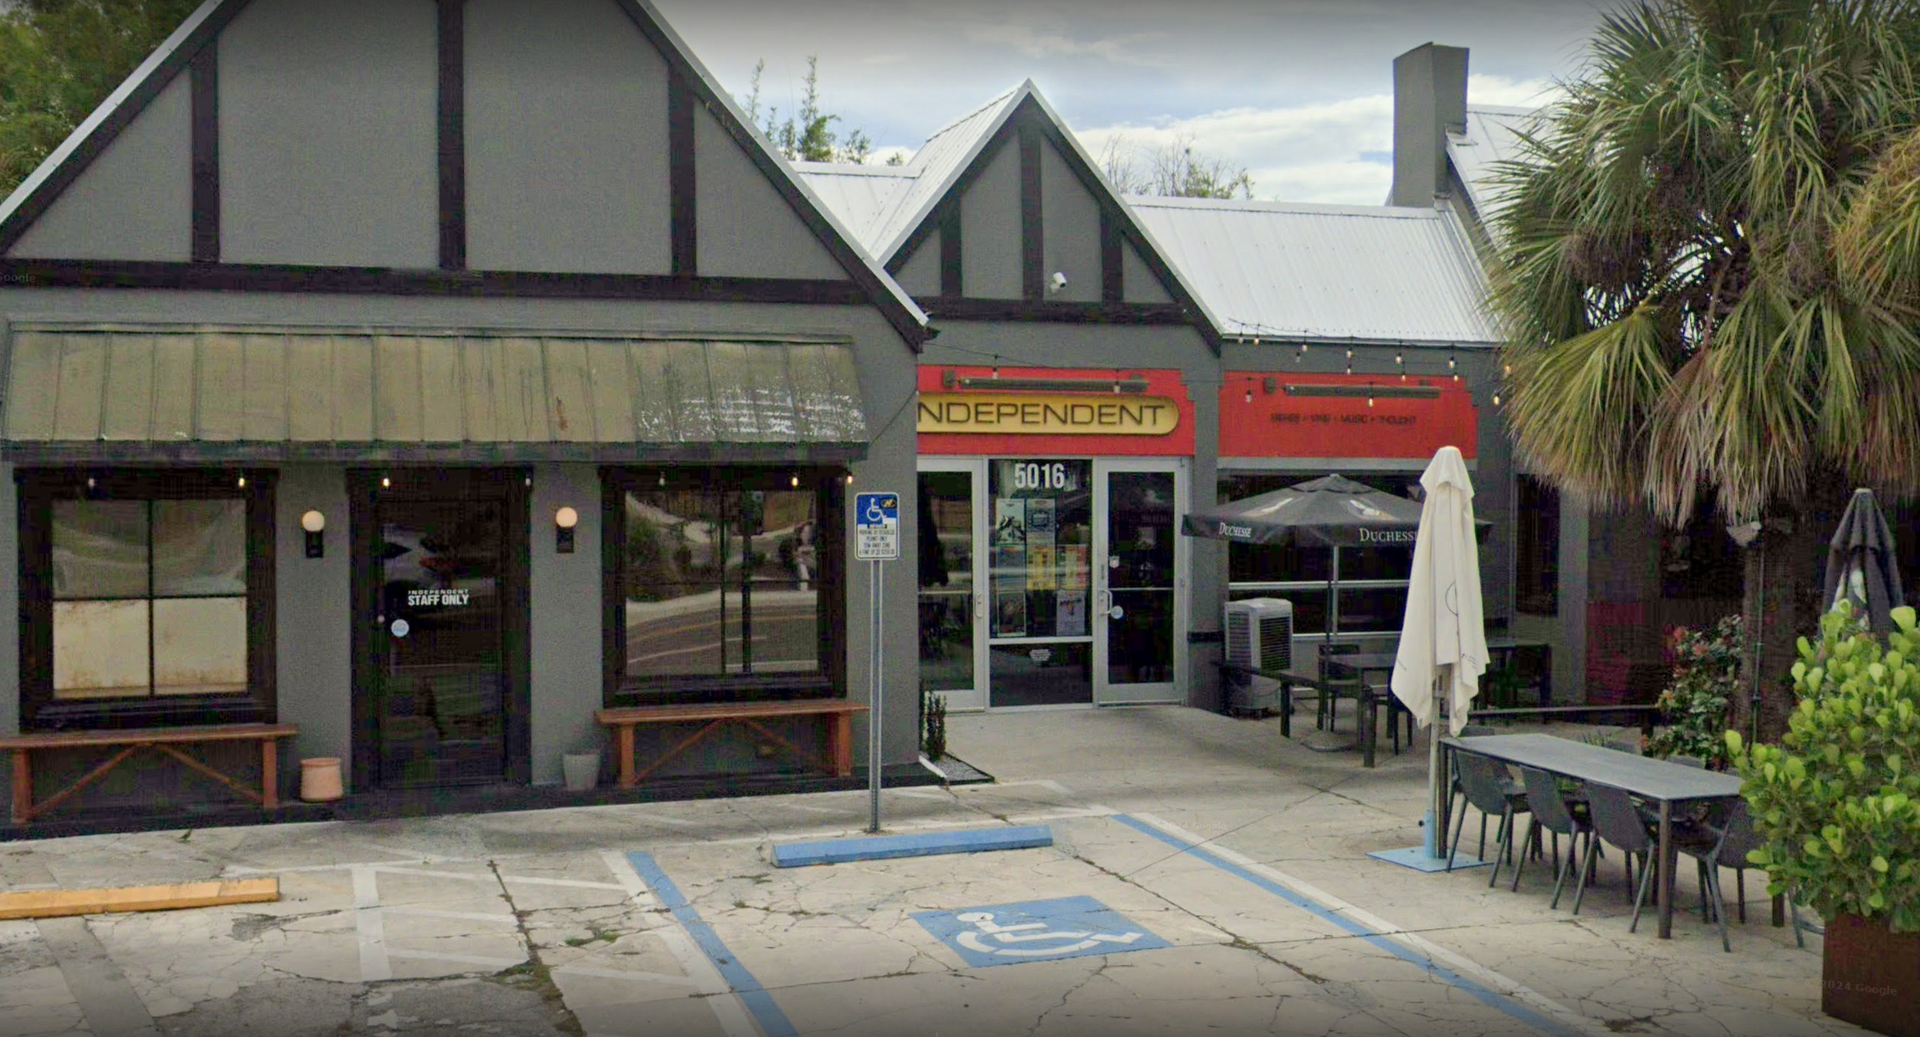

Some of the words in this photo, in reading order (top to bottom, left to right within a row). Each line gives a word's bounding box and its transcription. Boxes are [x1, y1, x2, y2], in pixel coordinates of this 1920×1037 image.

[917, 402, 1166, 426] NDEPENDENT
[1014, 462, 1065, 489] 5016
[408, 594, 440, 606] STAFF
[441, 594, 470, 606] ONLY
